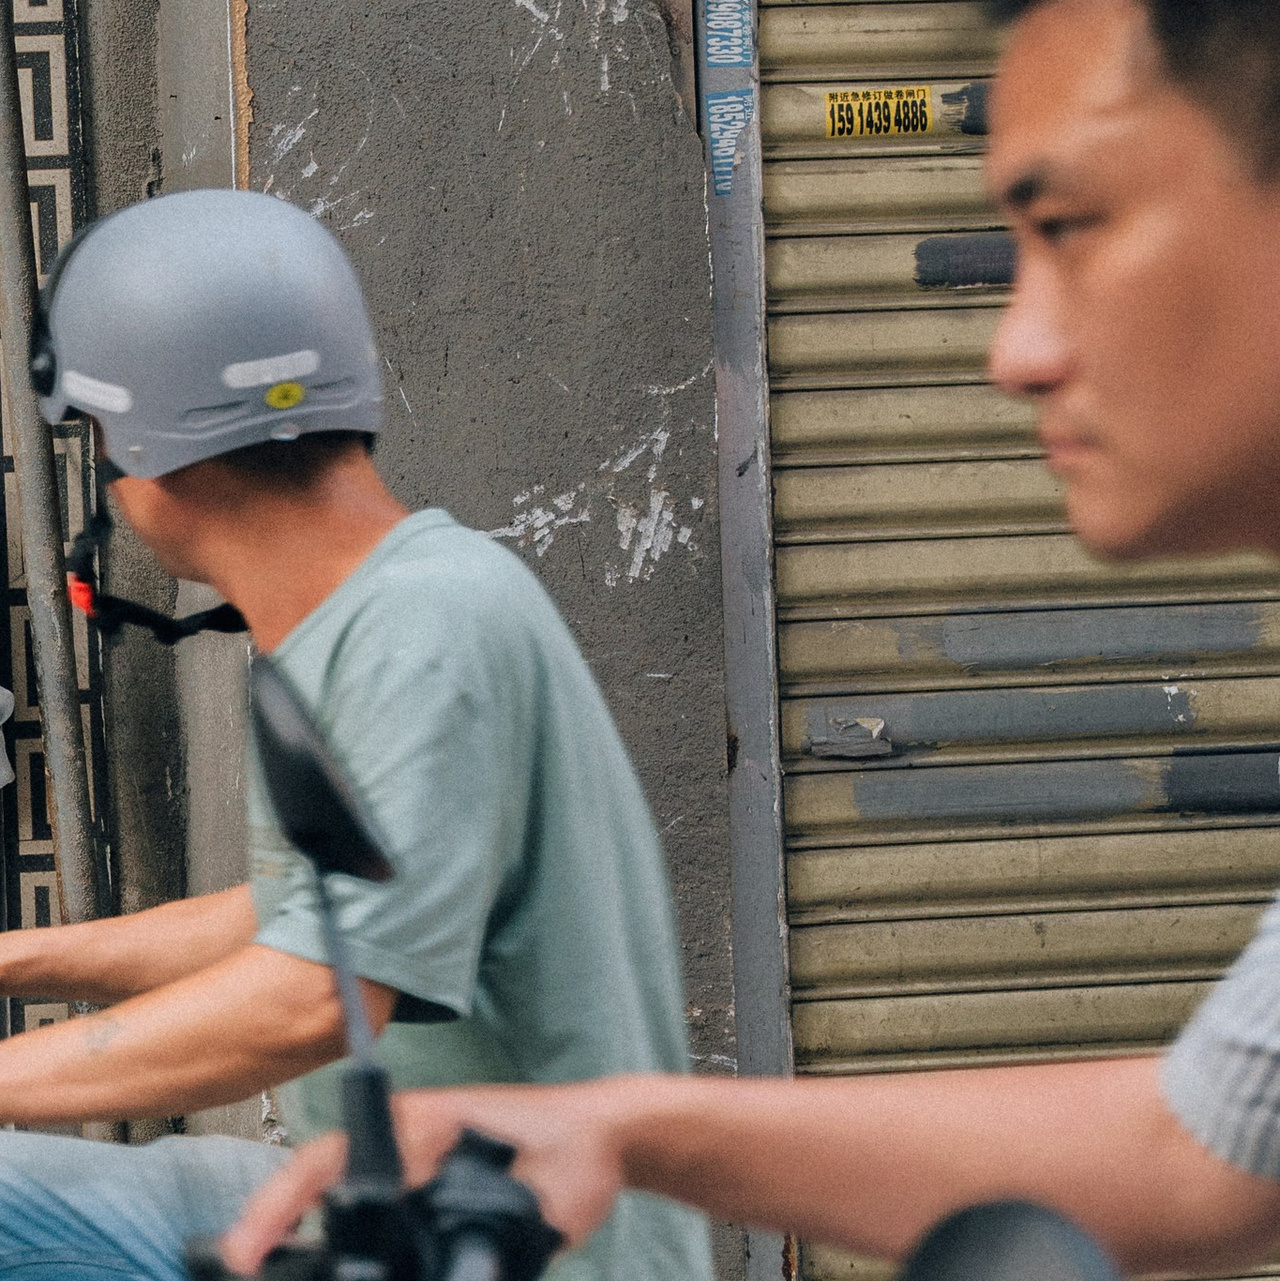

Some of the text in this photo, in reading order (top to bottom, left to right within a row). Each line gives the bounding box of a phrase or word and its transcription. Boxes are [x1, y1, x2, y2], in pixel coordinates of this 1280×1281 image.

[828, 88, 927, 102] 附近急修订做卷闸门
[830, 98, 928, 136] 159 1439 4886
